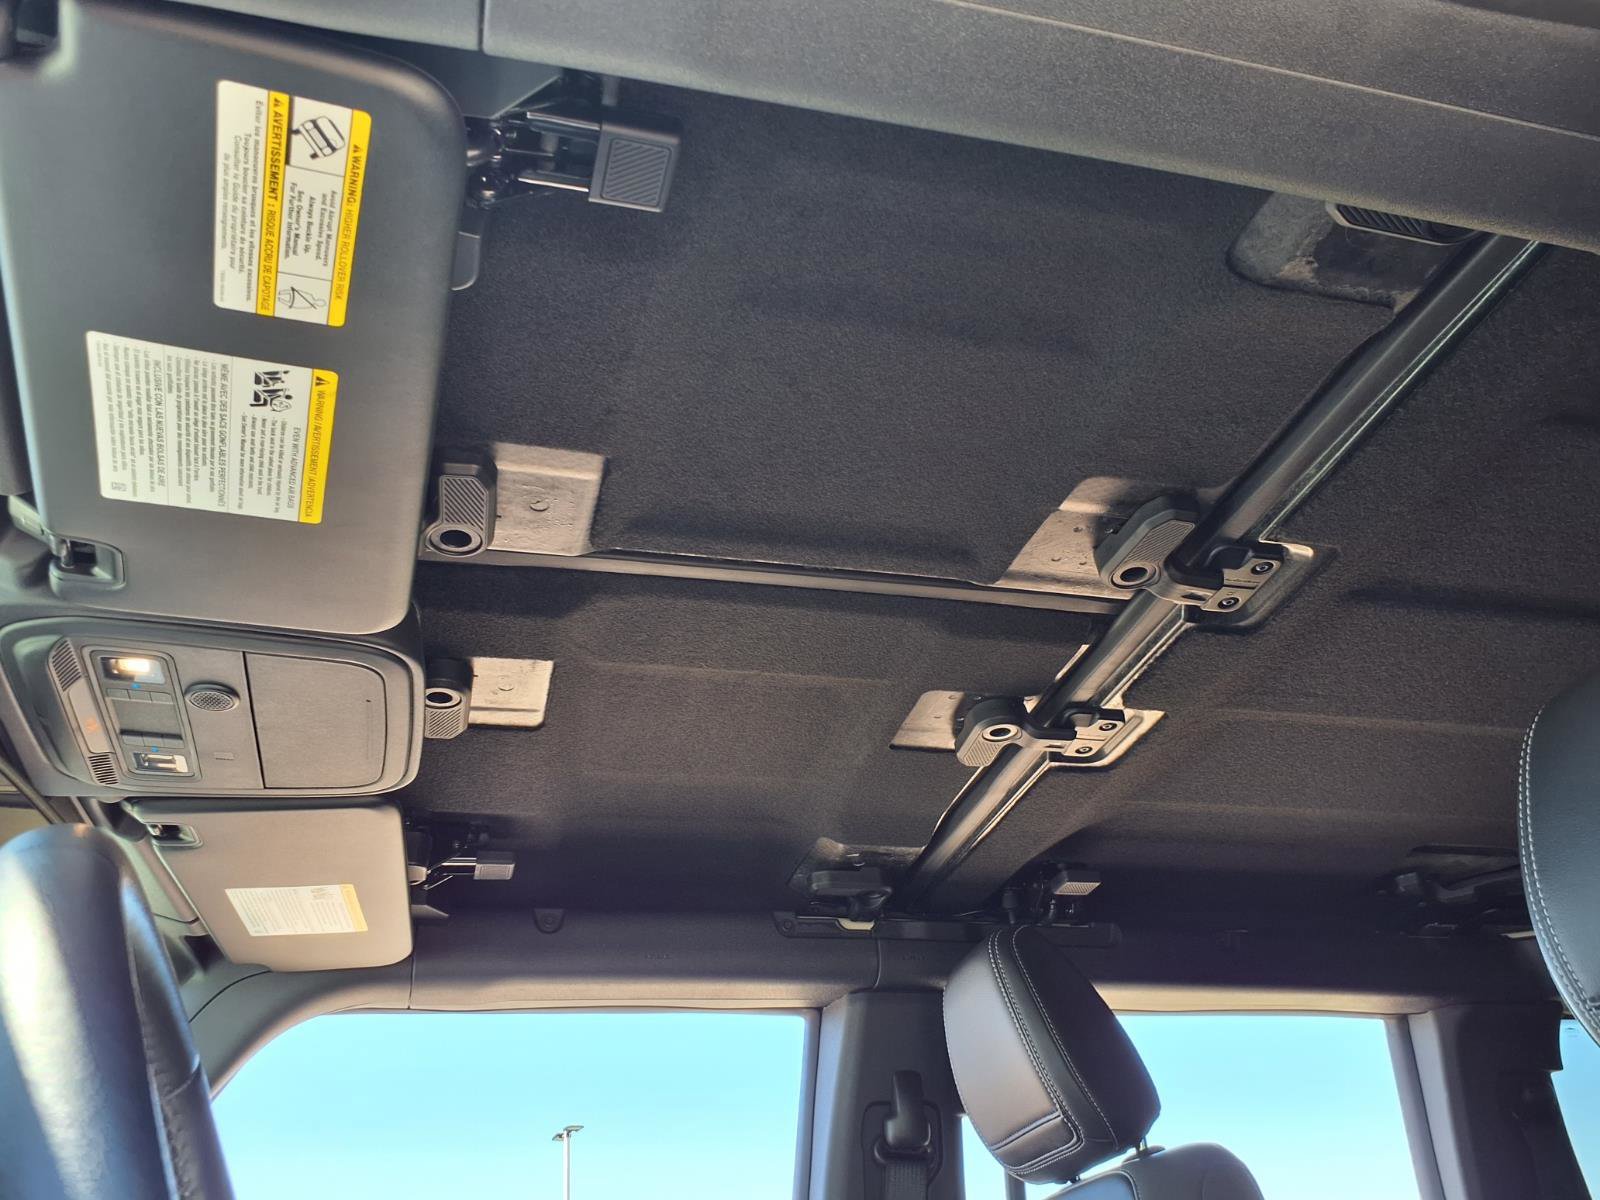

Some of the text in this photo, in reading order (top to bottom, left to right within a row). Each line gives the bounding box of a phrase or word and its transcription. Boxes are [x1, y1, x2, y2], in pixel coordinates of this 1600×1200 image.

[267, 110, 283, 200] AVERTISSEMENT
[265, 209, 277, 238] RISQUE
[335, 154, 361, 300] WARNING: HIGHER ROLLOVER RISK
[263, 238, 275, 264] ACCRU
[263, 264, 273, 274] DE
[261, 275, 273, 311] CAPOTAGE
[220, 363, 229, 382] MÊME
[154, 392, 162, 406] CON
[219, 382, 227, 399] AVEC
[154, 406, 163, 419] LAS
[219, 399, 227, 412] DES
[218, 429, 226, 466] GONFLABLES
[308, 424, 322, 475] AVERTISSEMENT
[286, 426, 300, 508] EVEN WITH ADVANCED AIR BAGS
